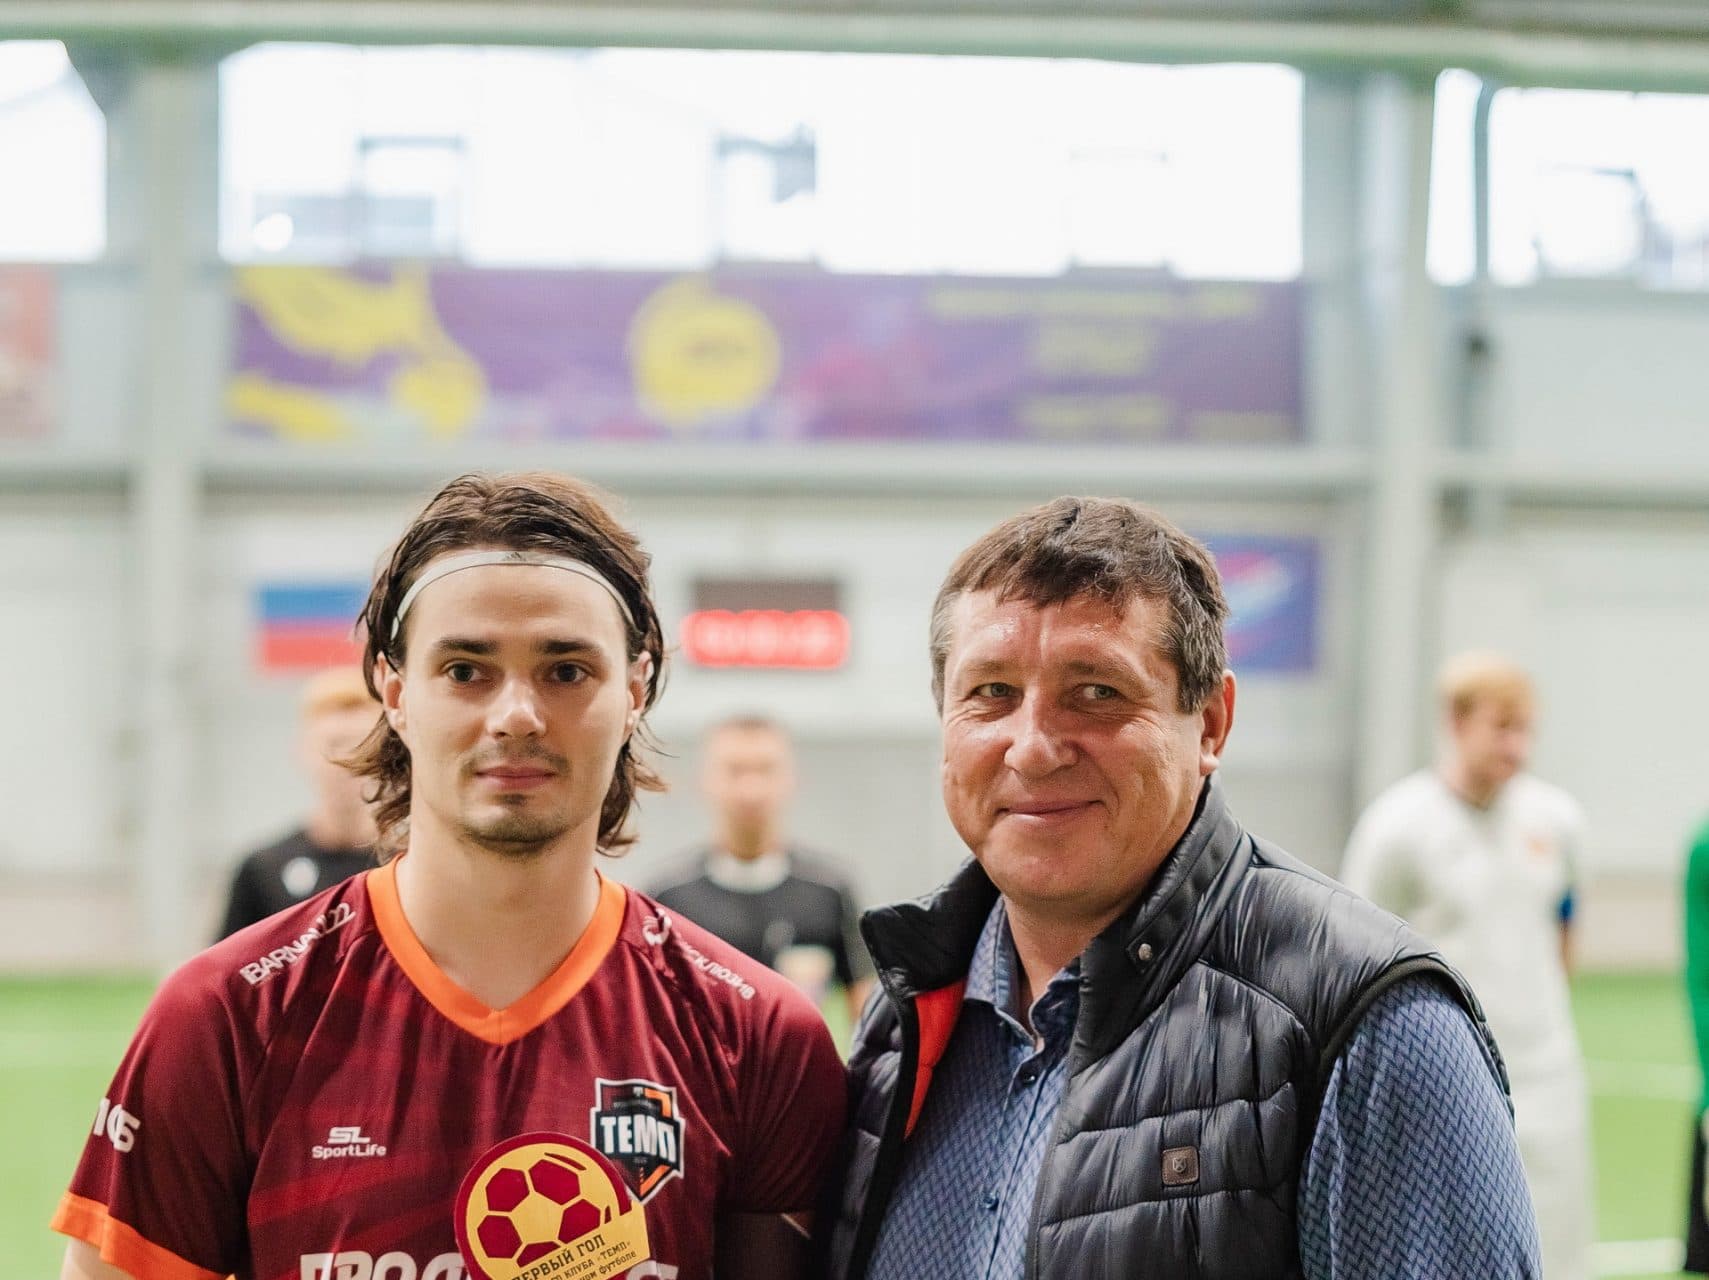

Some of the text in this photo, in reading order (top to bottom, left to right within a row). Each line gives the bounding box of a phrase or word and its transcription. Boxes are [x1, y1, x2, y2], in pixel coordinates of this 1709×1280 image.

[327, 1126, 371, 1144] SL
[600, 1114, 676, 1163] ТЕМП
[312, 1144, 387, 1160] SportLife
[576, 1234, 606, 1257] ГОЛ
[565, 1258, 596, 1279] КЛУБА
[599, 1250, 637, 1276] футболе
